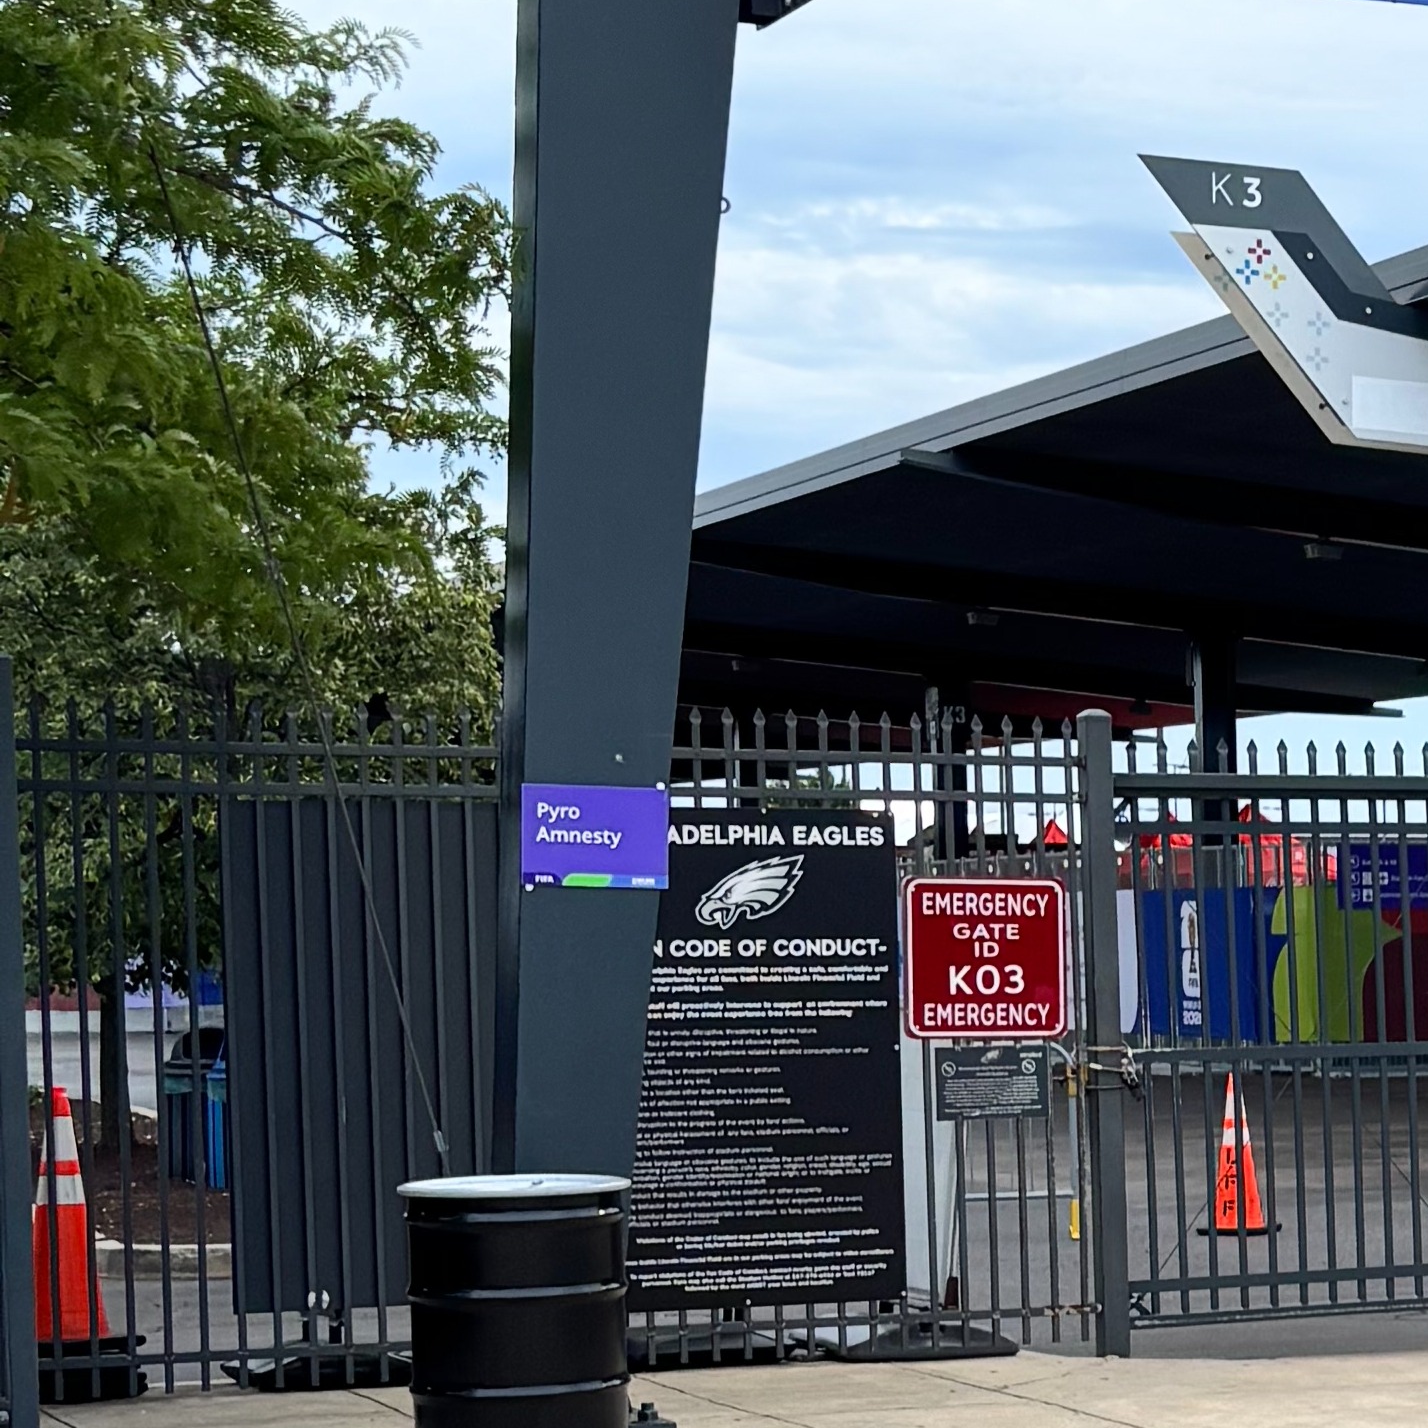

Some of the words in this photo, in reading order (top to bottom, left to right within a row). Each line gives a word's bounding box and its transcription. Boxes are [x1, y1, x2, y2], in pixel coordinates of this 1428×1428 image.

[1212, 171, 1234, 206] K
[1242, 176, 1262, 208] 3
[536, 802, 580, 823] Pyro
[536, 826, 622, 849] Amnesty
[667, 824, 786, 845] ADELPHIA
[793, 826, 885, 846] EAGLES
[922, 892, 1049, 917] EMERGENCY
[953, 923, 1020, 940] GATE
[669, 939, 732, 957] CODE
[737, 939, 767, 957] OF
[974, 941, 1000, 958] ID
[924, 1003, 1050, 1026] EMERGENCY
